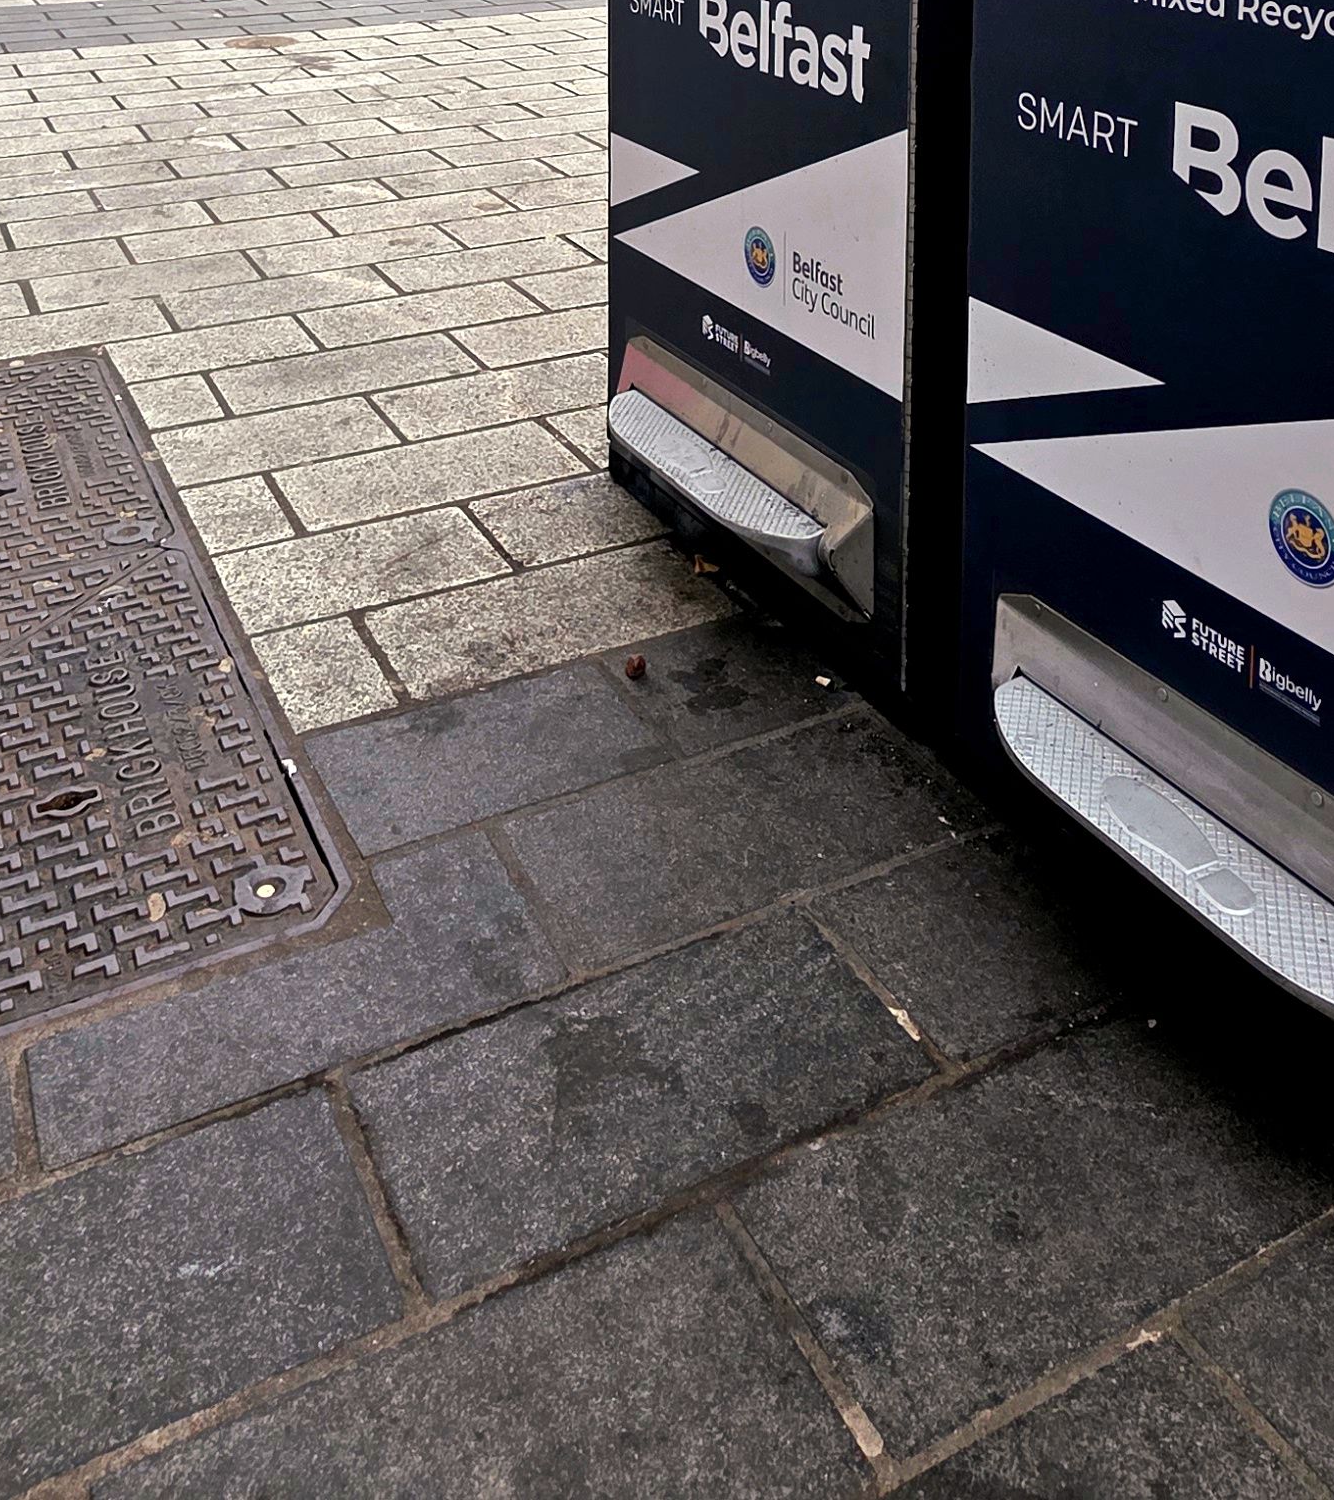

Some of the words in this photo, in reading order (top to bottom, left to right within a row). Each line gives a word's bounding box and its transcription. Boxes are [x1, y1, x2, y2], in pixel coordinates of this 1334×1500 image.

[1017, 92, 1139, 157] SMART
[793, 251, 844, 297] Belfast
[792, 277, 818, 313] City
[822, 292, 876, 340] Council
[715, 333, 739, 354] STREET
[13, 414, 72, 511] BRICKHOUSE
[1191, 618, 1246, 661] FUTURE
[1191, 632, 1245, 673] STREET
[1259, 658, 1322, 711] Bigbelly
[82, 650, 182, 839] BRICKHOUSE
